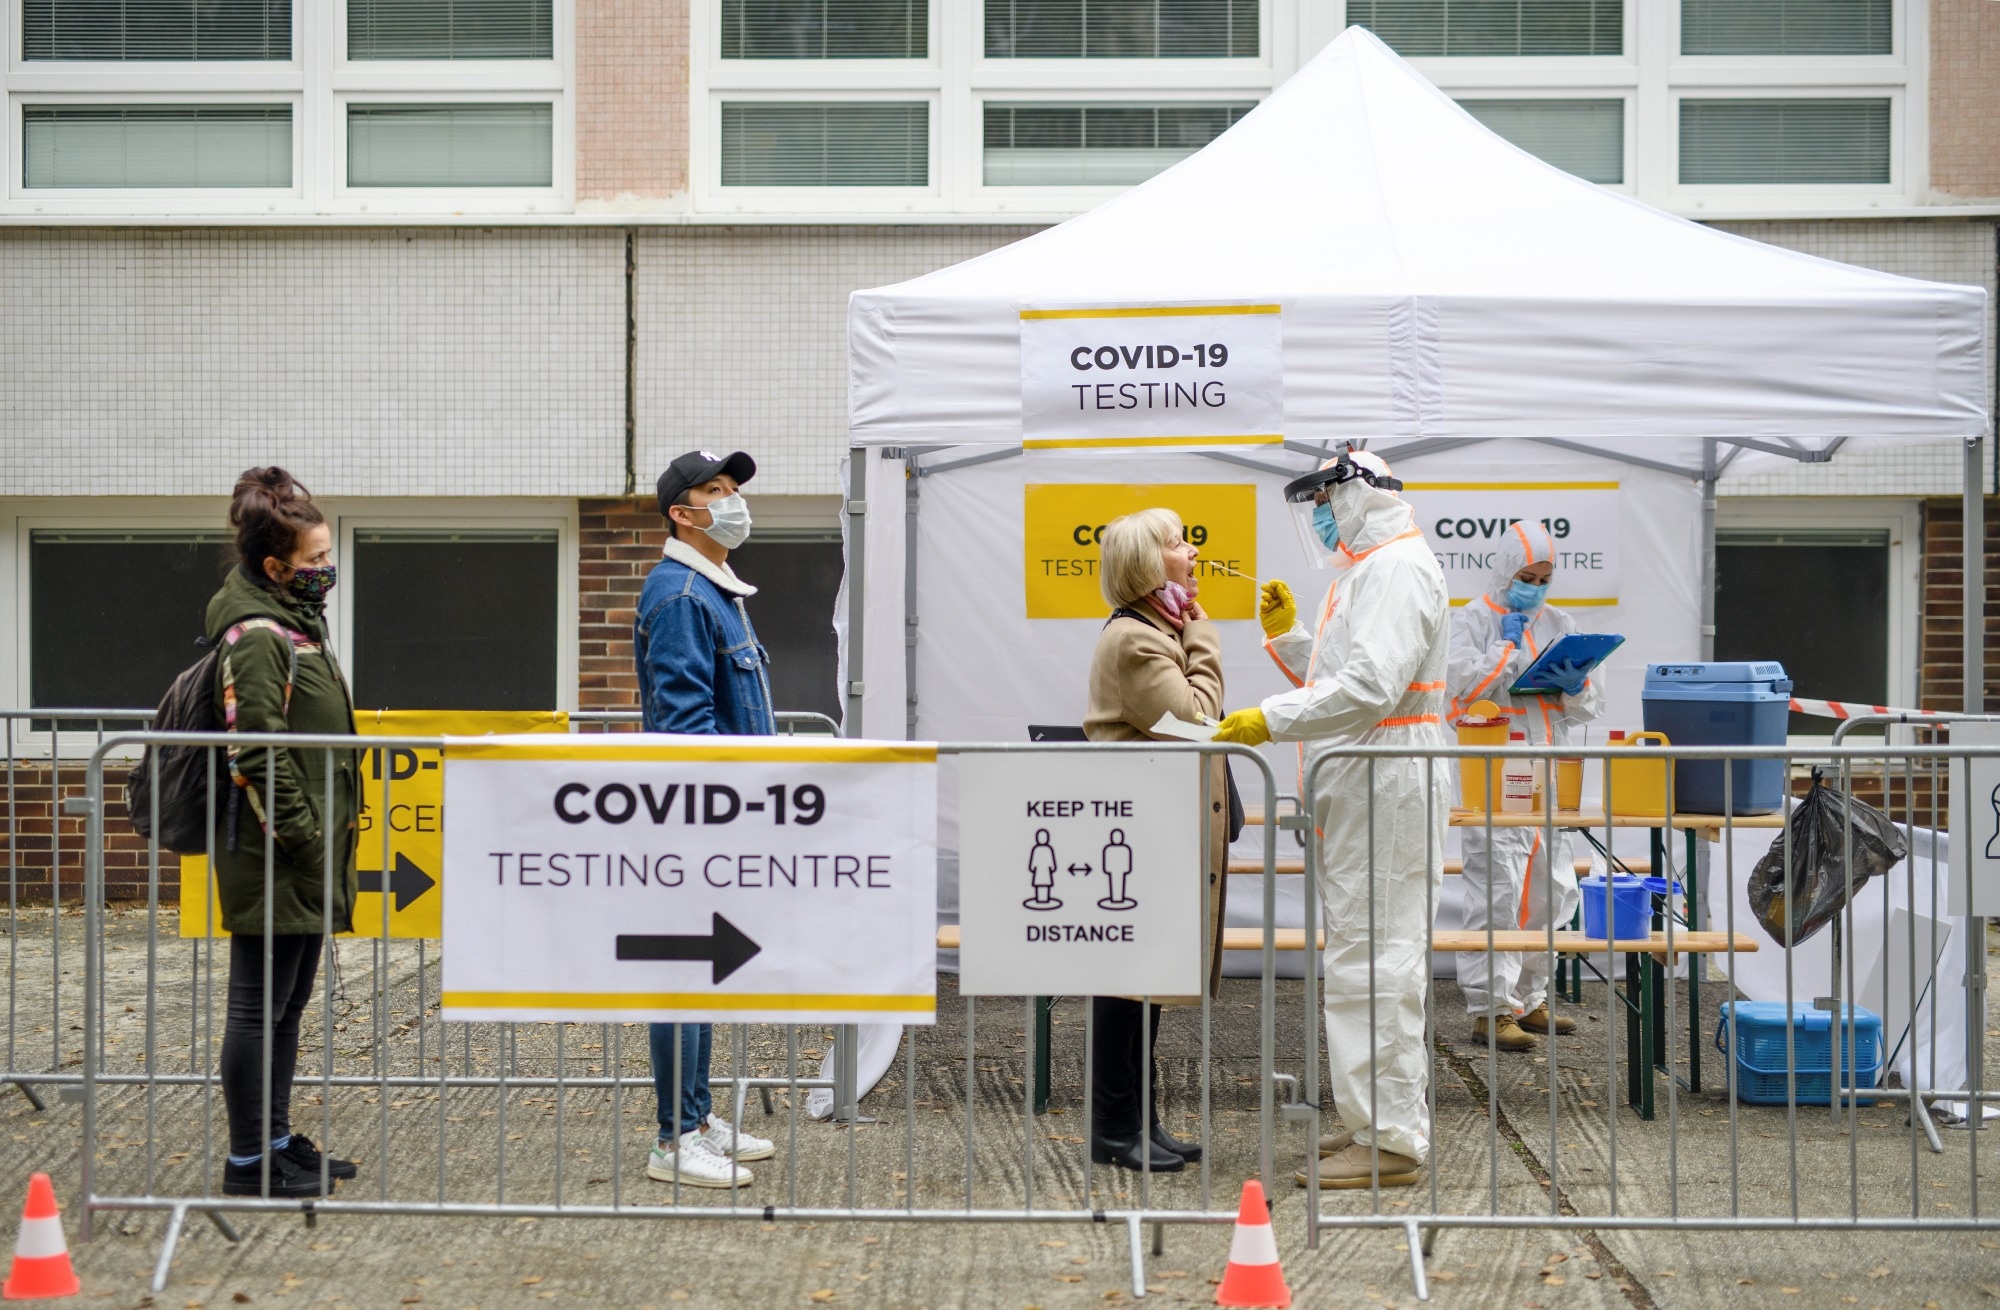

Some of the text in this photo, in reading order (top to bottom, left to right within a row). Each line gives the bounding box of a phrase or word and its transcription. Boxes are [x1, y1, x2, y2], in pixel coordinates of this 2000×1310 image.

[1070, 343, 1228, 371] COVID-19
[1071, 381, 1226, 410] TESTING
[1435, 517, 1571, 539] COVI19
[1041, 559, 1241, 577] TEST TRE
[1554, 551, 1604, 570] TRE
[553, 782, 826, 826] COVID-19
[1027, 800, 1133, 817] KEEP THE
[489, 852, 892, 889] TESTING CENTRE
[1026, 924, 1134, 942] DISTANCE
